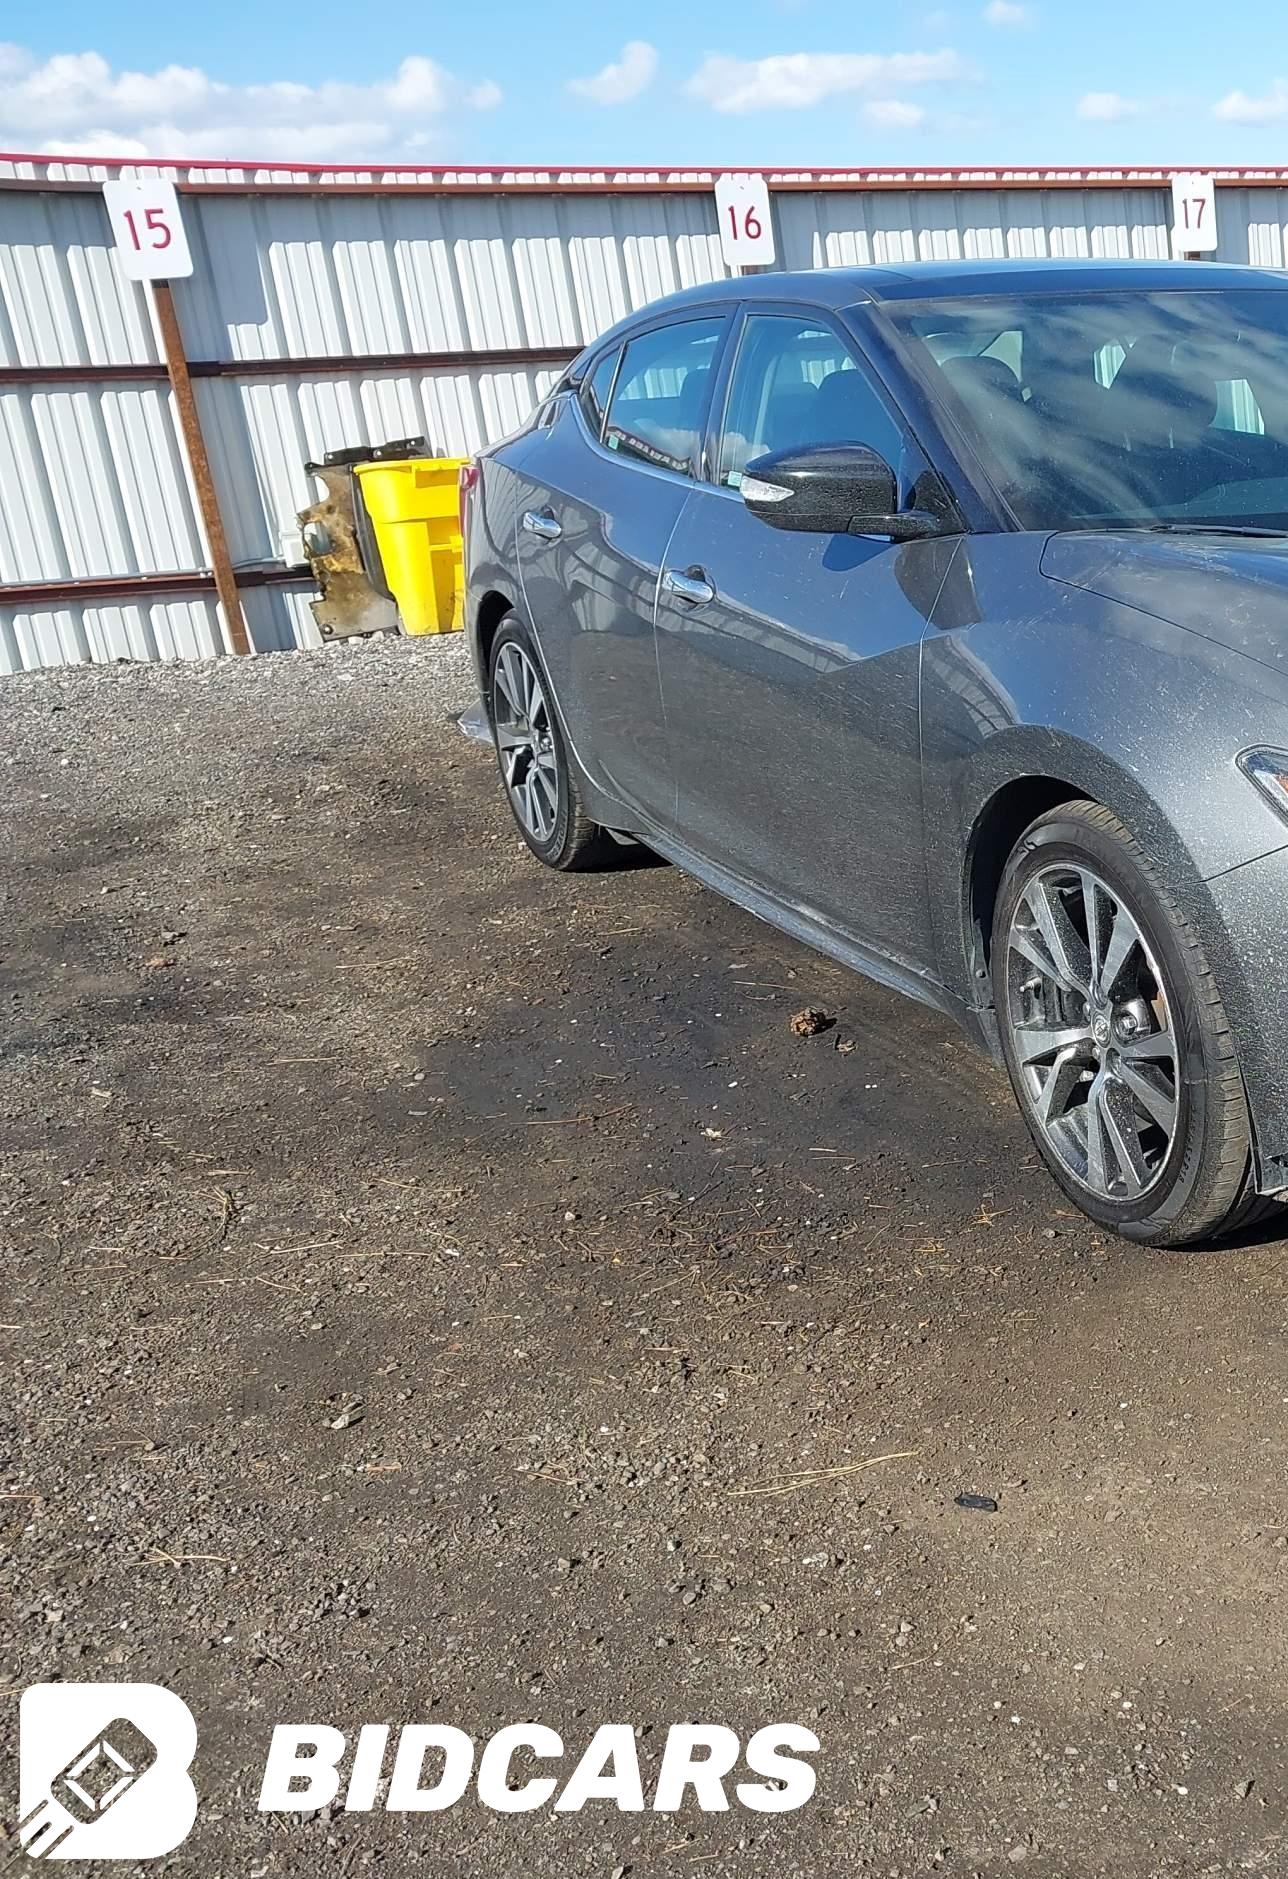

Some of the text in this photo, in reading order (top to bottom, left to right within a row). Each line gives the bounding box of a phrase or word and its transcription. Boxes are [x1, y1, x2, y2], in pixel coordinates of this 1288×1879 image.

[123, 208, 171, 251] 15
[728, 205, 762, 241] 16
[1182, 198, 1206, 229] 17
